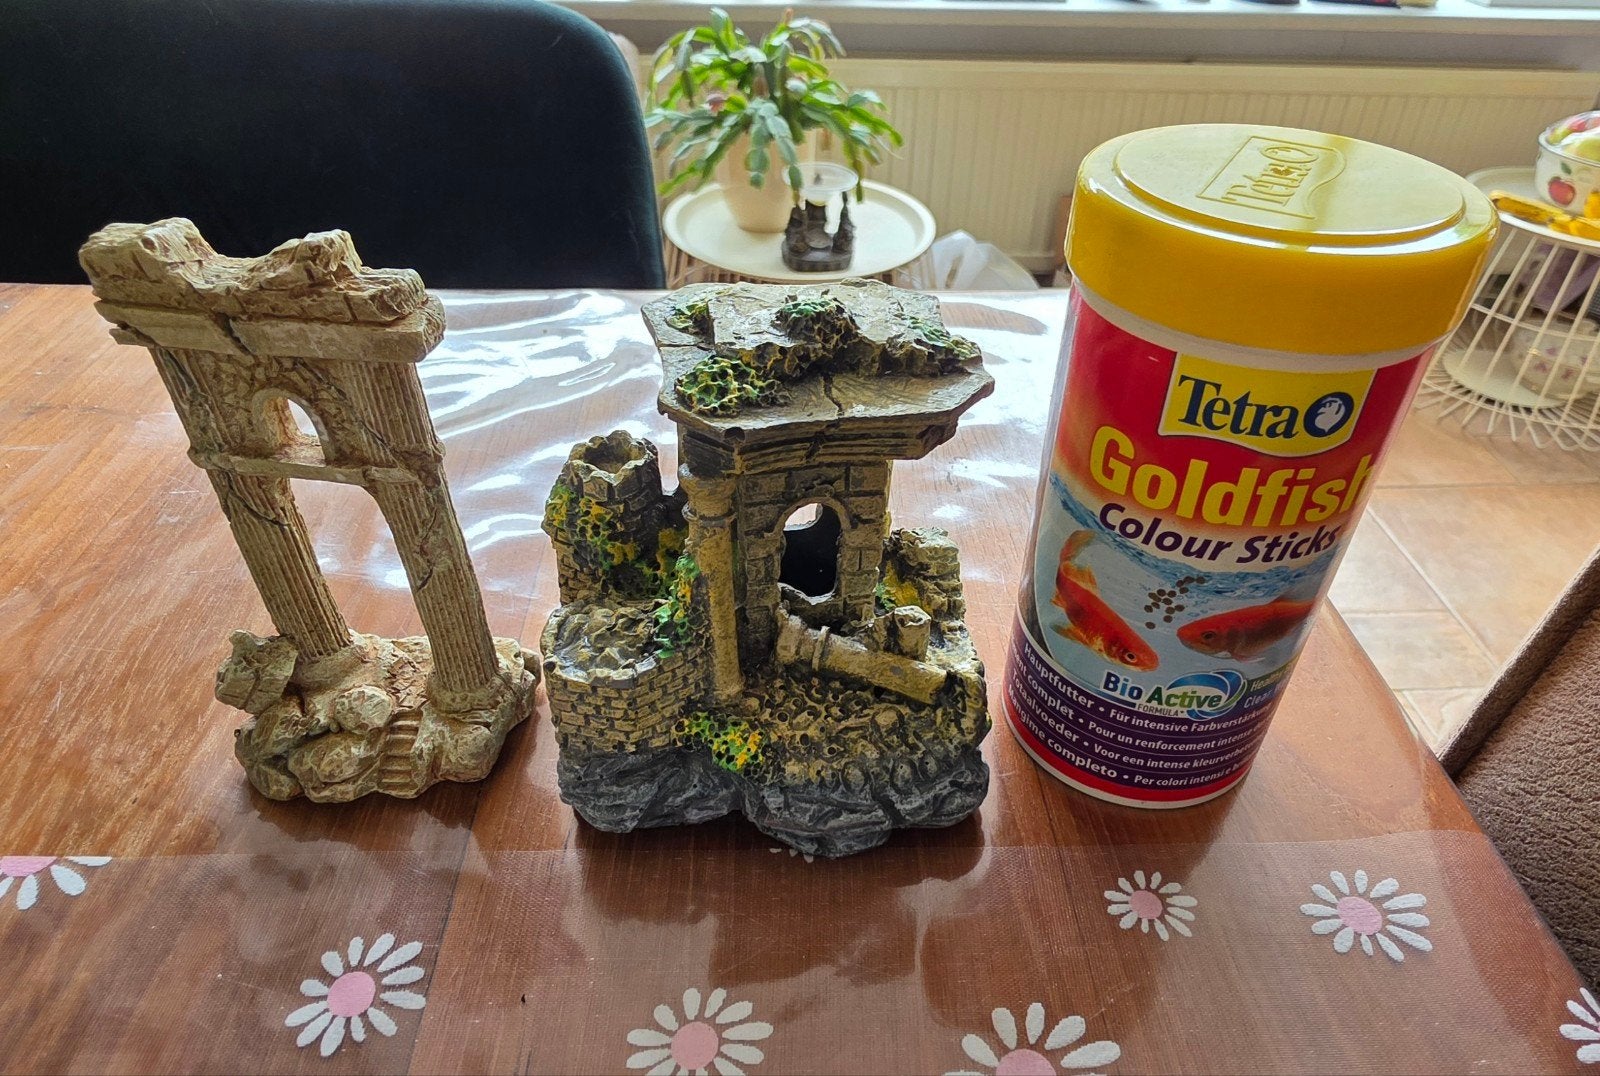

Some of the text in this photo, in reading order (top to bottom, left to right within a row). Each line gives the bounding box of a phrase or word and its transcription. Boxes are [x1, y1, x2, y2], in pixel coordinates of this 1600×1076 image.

[1177, 374, 1299, 439] Tetra
[1089, 425, 1375, 528] Goldfish
[1100, 502, 1343, 564] Colour Sticks
[1012, 667, 1080, 743] Totaalvoeder
[1094, 743, 1120, 760] Voor
[1122, 755, 1145, 766] een
[1146, 758, 1191, 769] intense
[1024, 642, 1095, 709] Hauptfutter
[1109, 708, 1130, 723] Für
[1131, 715, 1188, 732] intensive
[1027, 674, 1075, 720] complet
[1088, 721, 1116, 738] Pour
[1117, 734, 1133, 744] un
[1135, 740, 1217, 751] renforcement
[1103, 671, 1224, 709] Bio Active
[1008, 684, 1046, 740] Mangime
[1047, 738, 1118, 778] completo
[1133, 775, 1155, 785] Per
[1156, 778, 1188, 786] colori
[1189, 770, 1224, 785] intensi
